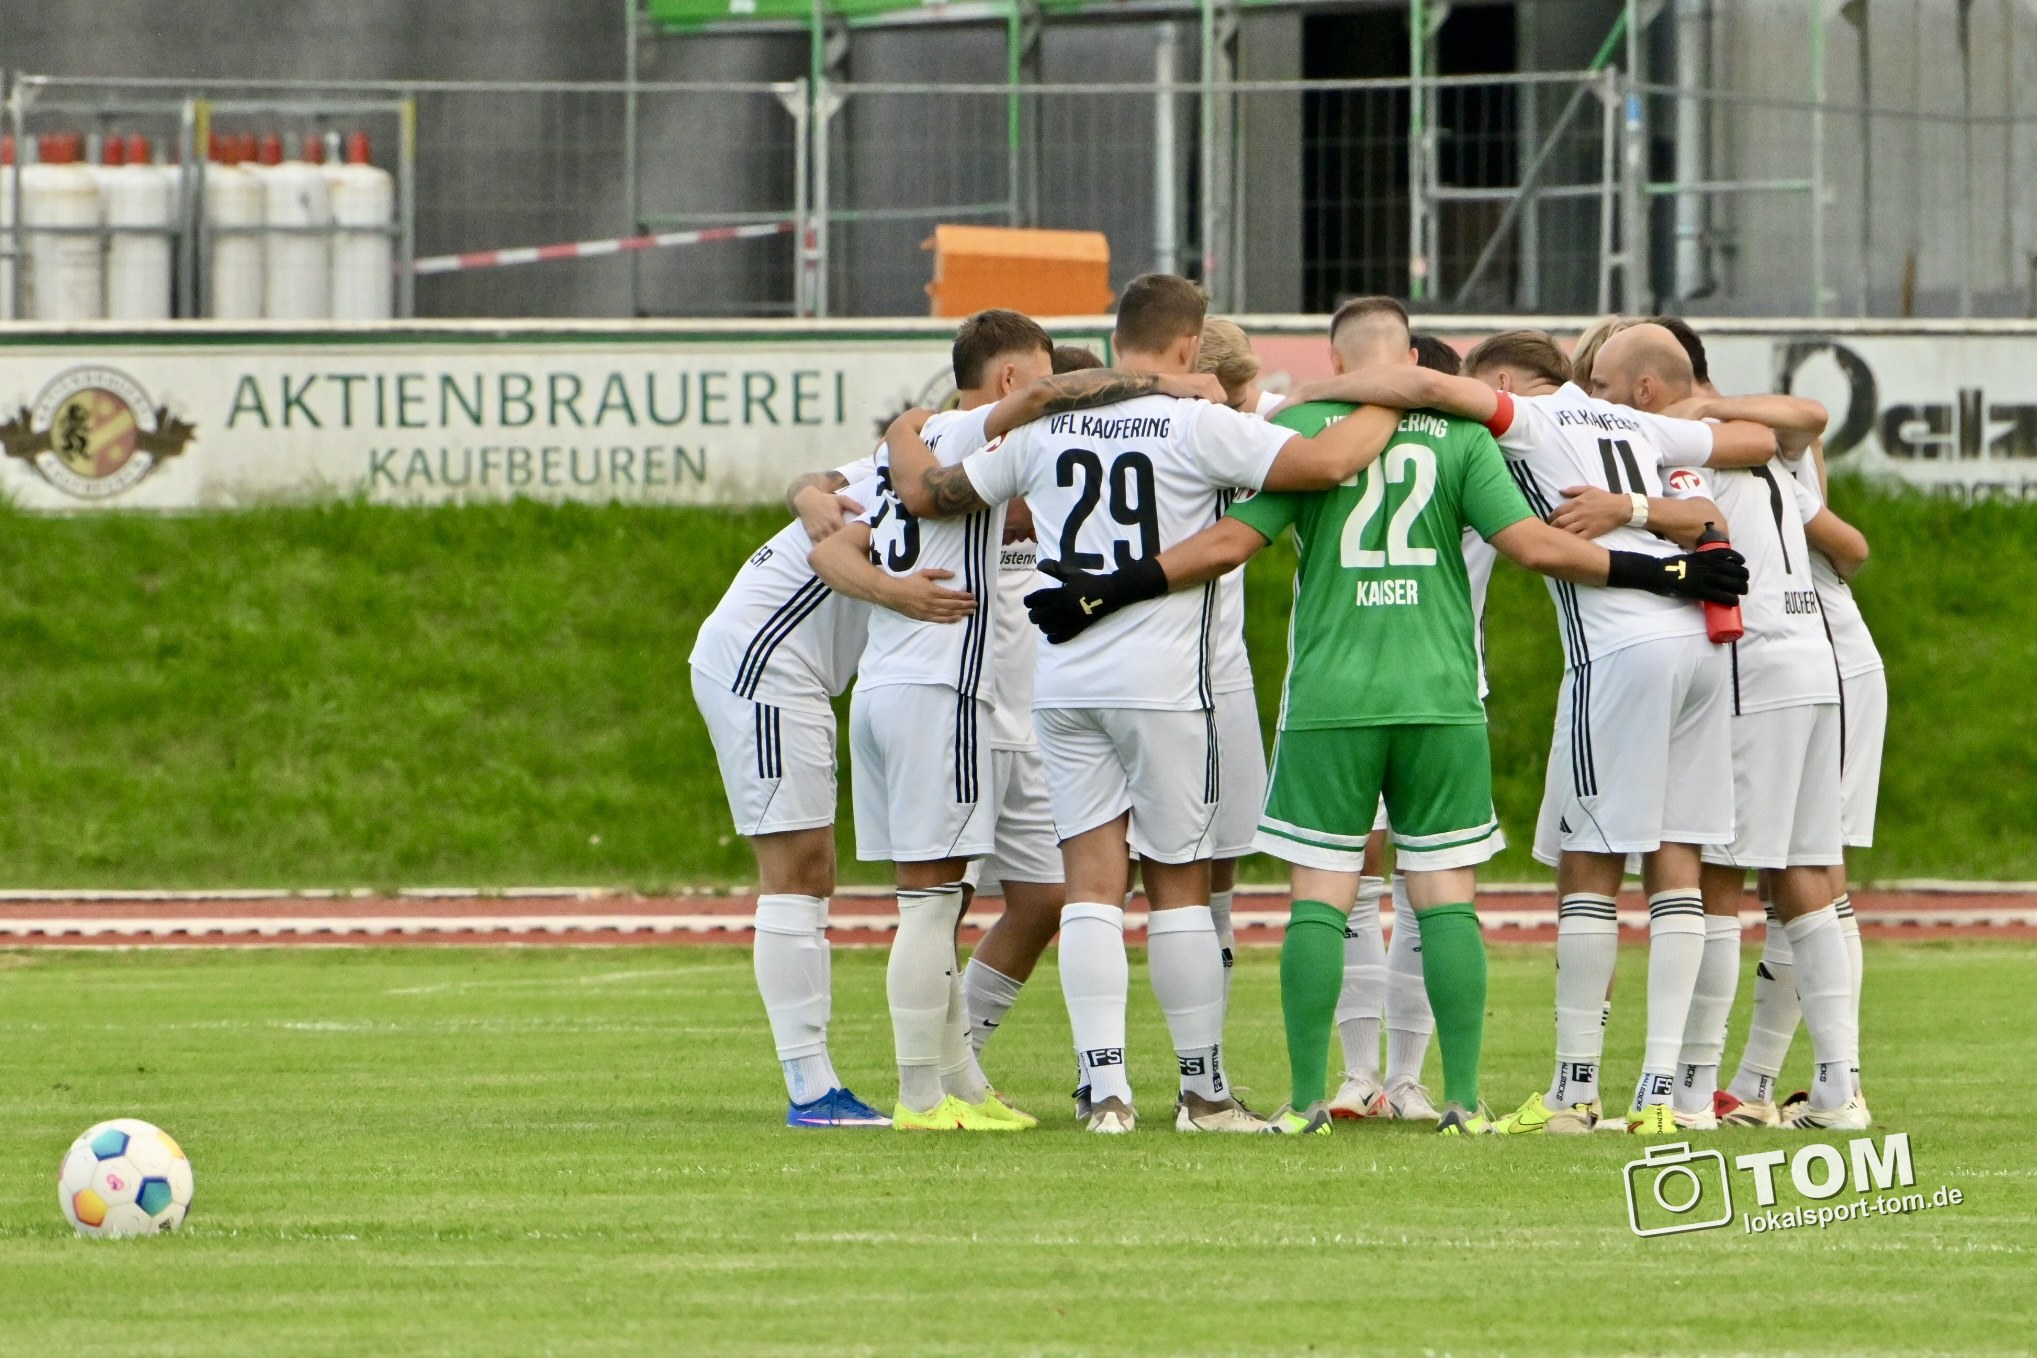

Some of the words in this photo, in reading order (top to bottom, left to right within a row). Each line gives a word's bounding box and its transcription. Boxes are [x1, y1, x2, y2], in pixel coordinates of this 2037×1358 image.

[226, 371, 845, 428] AKTIENBRAUEREI
[1051, 414, 1077, 434] VFL
[1080, 415, 1171, 439] KAUFERING
[1397, 413, 1449, 438] ERING
[369, 445, 706, 487] KAUFBEUREN
[1056, 448, 1161, 570] 29
[1339, 443, 1437, 568] 22
[1356, 579, 1418, 607] KAISER
[1784, 591, 1817, 614] BUCHER
[1090, 1049, 1121, 1066] FS
[1556, 1062, 1569, 1102] ALLSOCKS
[1653, 1077, 1672, 1095] FS
